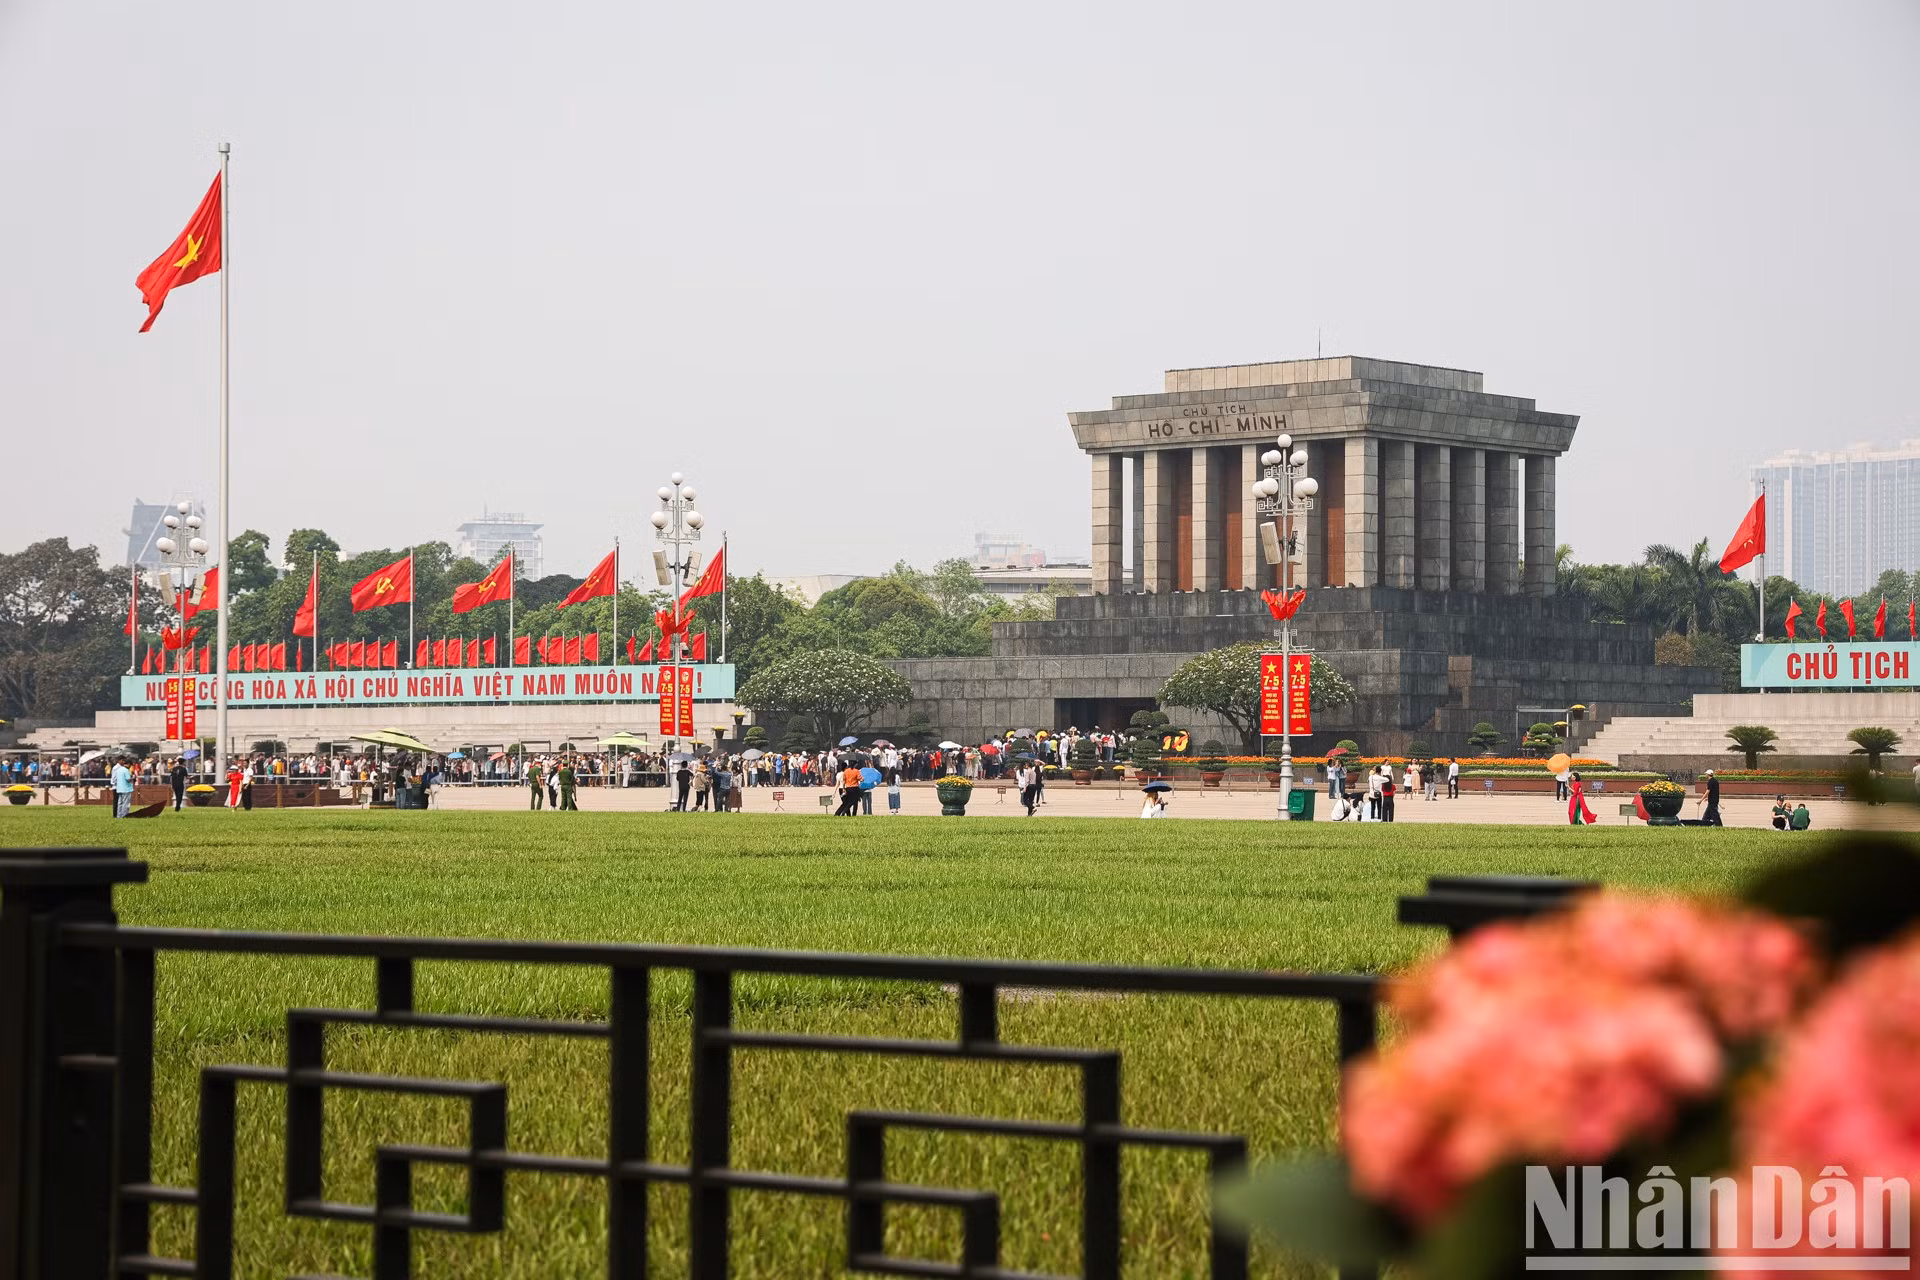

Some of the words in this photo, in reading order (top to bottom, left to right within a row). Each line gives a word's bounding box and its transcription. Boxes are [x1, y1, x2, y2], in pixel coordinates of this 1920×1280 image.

[1787, 644, 1838, 680] CHỦ
[1850, 651, 1909, 684] TỊCH
[252, 676, 287, 699] HÒA
[294, 675, 317, 699] XÃ
[325, 675, 354, 701] HỘI
[363, 672, 398, 698] CHỦ
[407, 672, 464, 697] NGHĨA
[473, 671, 514, 699] VIỆT
[523, 674, 566, 695] NAM
[575, 669, 632, 695] MUÔN
